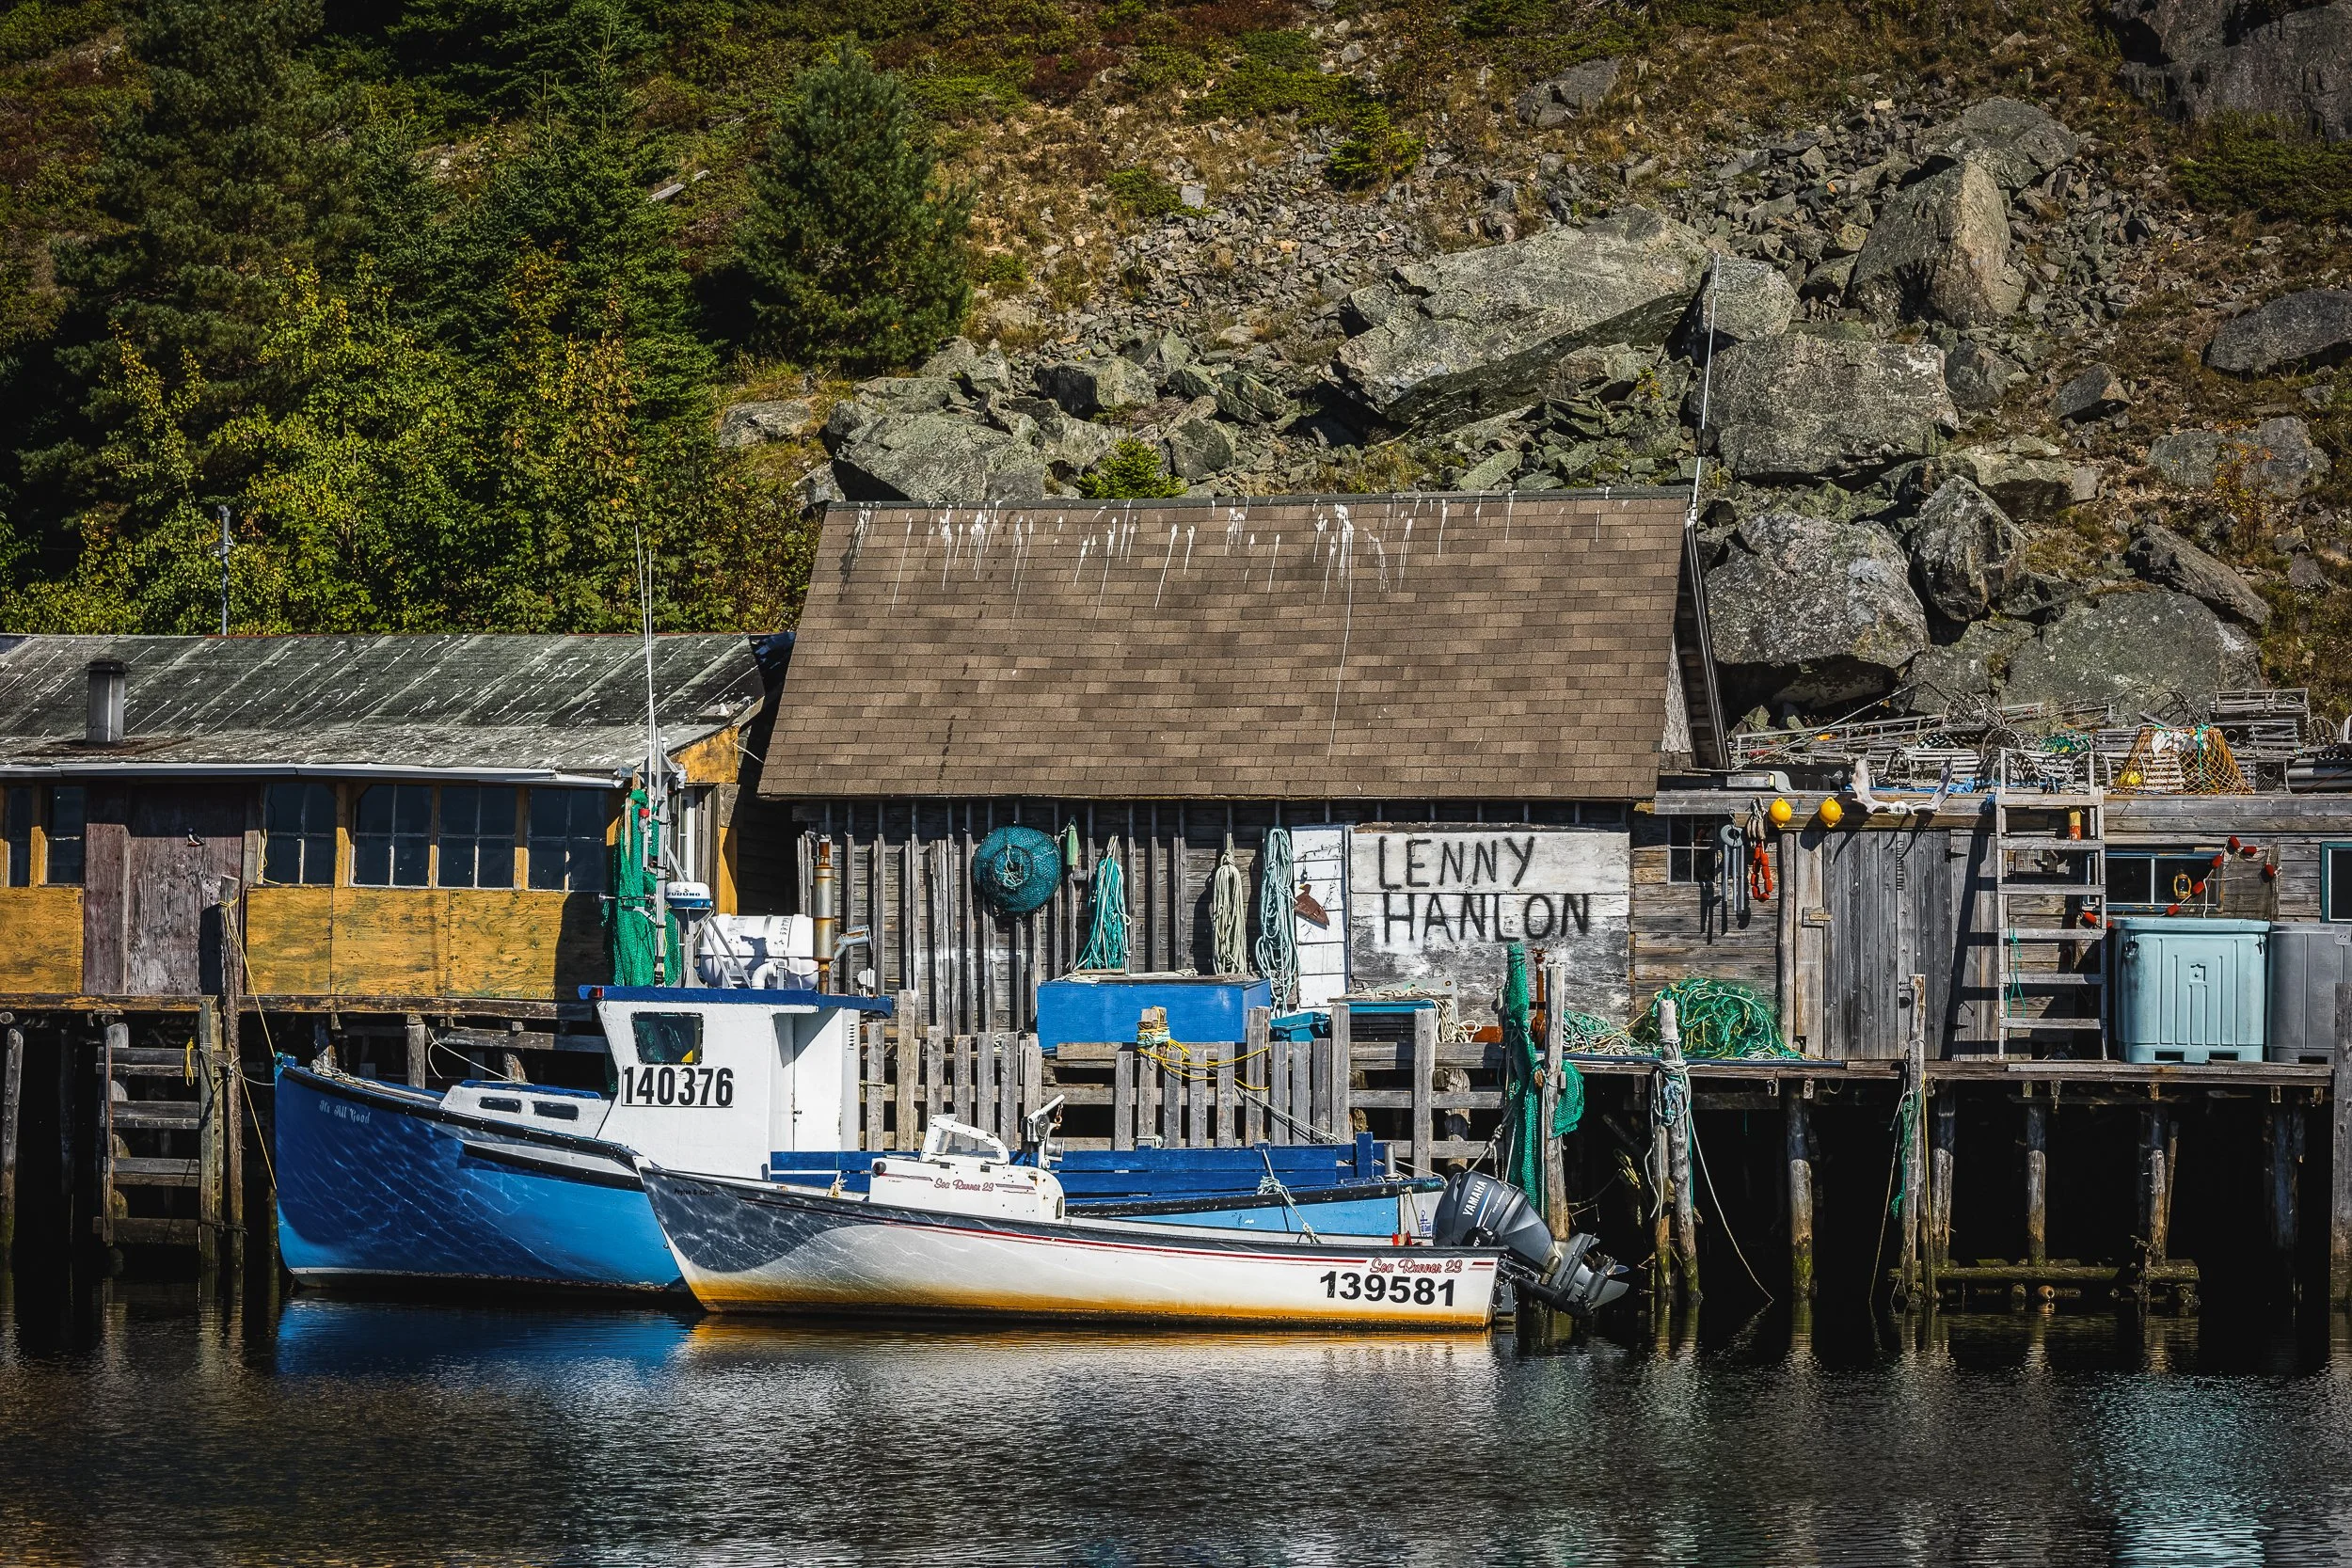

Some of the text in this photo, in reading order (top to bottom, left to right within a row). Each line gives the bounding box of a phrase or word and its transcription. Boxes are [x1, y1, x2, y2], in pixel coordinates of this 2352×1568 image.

[1378, 835, 1535, 890] LENNY
[1383, 893, 1590, 942] HANLON
[624, 1066, 734, 1106] 140376
[349, 1108, 371, 1124] Good
[934, 1178, 951, 1189] Sea
[952, 1179, 981, 1191] Runner
[1462, 1180, 1488, 1216] YAMAHA
[1369, 1257, 1395, 1274] Sea
[1397, 1258, 1442, 1274] Runner
[1320, 1271, 1455, 1307] 139581
